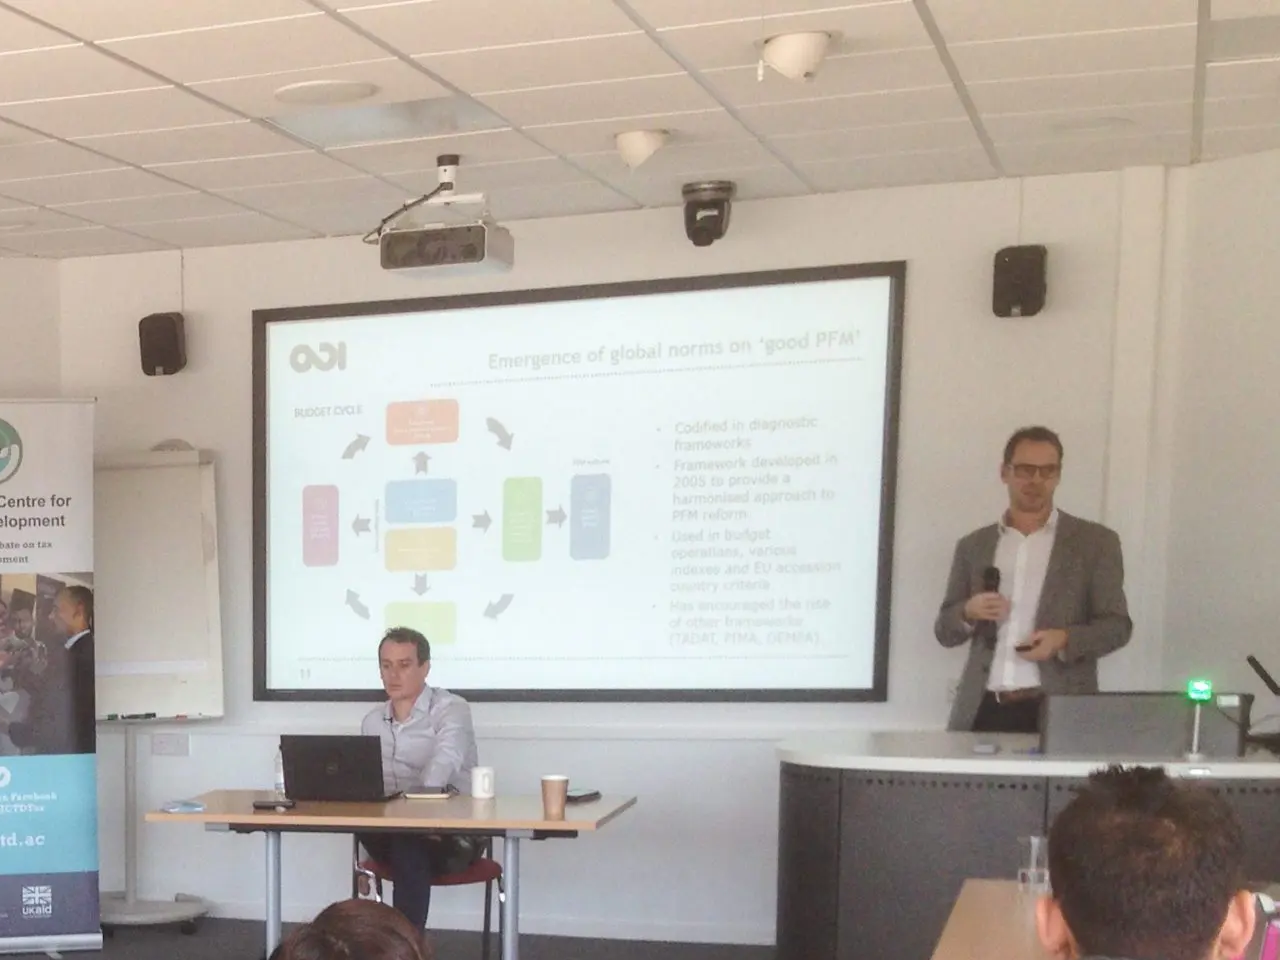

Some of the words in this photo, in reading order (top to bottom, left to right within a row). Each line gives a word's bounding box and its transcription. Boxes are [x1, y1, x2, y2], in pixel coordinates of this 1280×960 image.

[488, 352, 581, 371] Emergence
[587, 346, 605, 362] of
[610, 344, 661, 365] global
[668, 342, 723, 358] norms
[729, 340, 752, 354] on
[759, 332, 810, 353] 'good
[816, 329, 861, 348] PFM'
[294, 406, 331, 418] BUDGET
[333, 405, 363, 416] CYCLE
[674, 421, 728, 435] Codified
[732, 420, 744, 432] in
[748, 416, 819, 433] diagnostic
[674, 437, 753, 452] frameworks
[673, 457, 746, 471] Framework
[751, 454, 821, 470] developed
[825, 454, 838, 467] in
[673, 476, 706, 489] 2005
[711, 476, 724, 487] to
[728, 474, 778, 489] provide
[781, 475, 791, 485] a
[50, 494, 72, 508] for
[672, 491, 749, 506] harmonised
[753, 488, 816, 506] approach
[820, 487, 835, 501] to
[672, 509, 699, 522] PFM
[702, 508, 747, 521] reform
[671, 529, 704, 542] Used
[708, 528, 720, 541] in
[724, 527, 771, 544] budget
[23, 541, 35, 550] on
[37, 540, 53, 549] tax
[670, 547, 743, 561] operations,
[748, 545, 797, 556] various
[670, 563, 721, 576] indexes
[724, 562, 749, 575] and
[753, 561, 771, 575] EU
[775, 562, 842, 574] accession
[669, 579, 719, 594] country
[723, 578, 771, 591] criteria
[669, 600, 694, 612] Has
[698, 598, 776, 614] encouraged
[778, 596, 802, 610] the
[805, 596, 831, 610] rise
[668, 616, 682, 629] of
[685, 615, 720, 629] other
[300, 668, 311, 680] 11
[11, 792, 57, 802] Facebook
